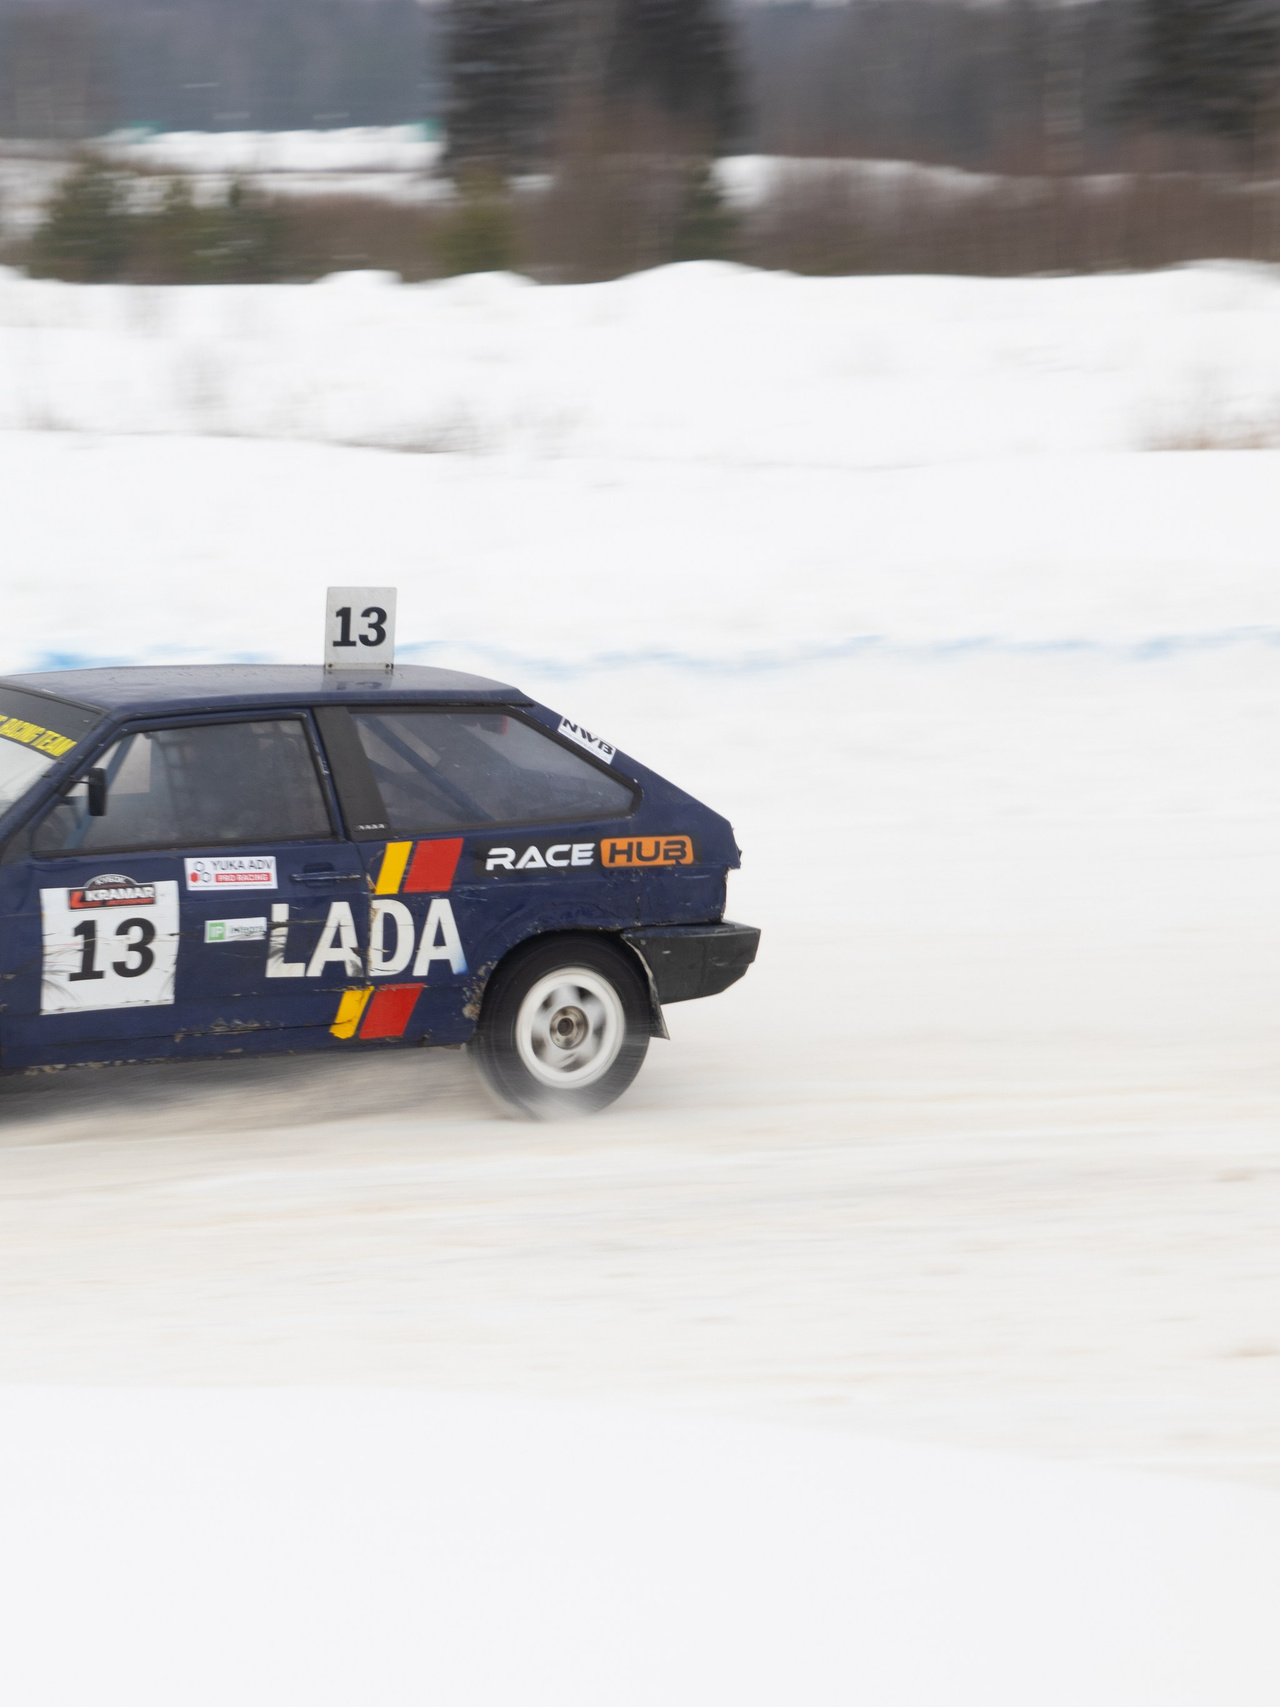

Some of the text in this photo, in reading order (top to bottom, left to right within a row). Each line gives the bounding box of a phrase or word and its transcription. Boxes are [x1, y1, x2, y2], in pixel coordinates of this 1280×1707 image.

[332, 606, 388, 647] 13
[30, 730, 78, 757] TEAM
[562, 718, 614, 755] NWB
[210, 859, 274, 871] YUKA ADV
[485, 840, 687, 871] RACE HUB
[85, 886, 155, 901] KRAMAR
[68, 916, 157, 982] 13
[264, 898, 469, 979] LADA
